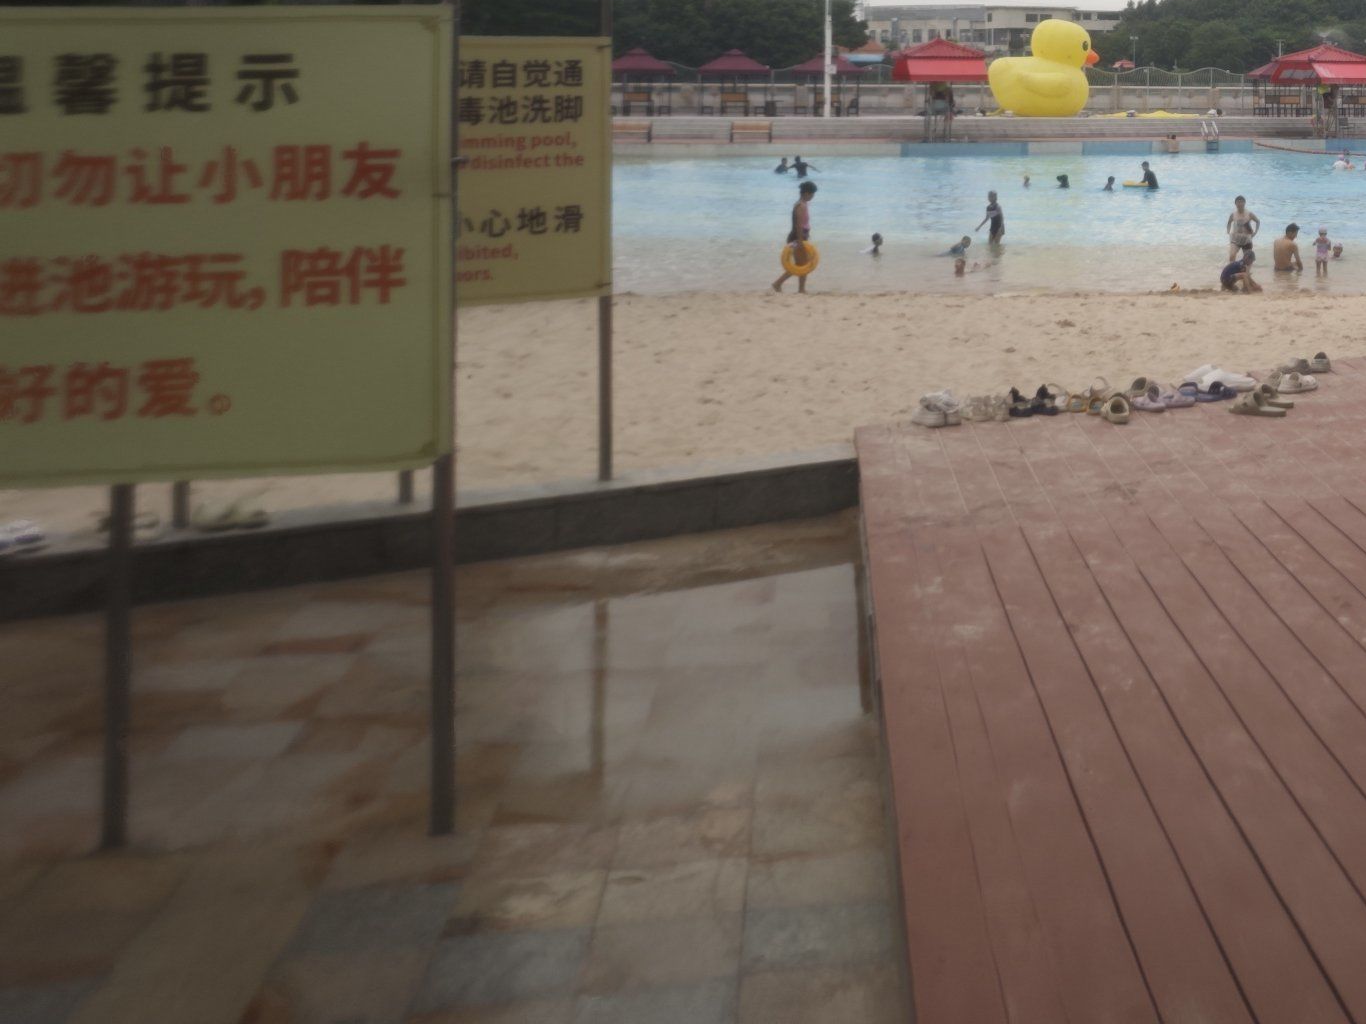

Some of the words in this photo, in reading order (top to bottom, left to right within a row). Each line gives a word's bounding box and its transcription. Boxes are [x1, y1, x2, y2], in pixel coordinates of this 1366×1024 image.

[459, 59, 584, 89] 请自觉通
[459, 95, 584, 126] 毒池洗脚
[531, 131, 577, 150] pool,
[471, 153, 550, 169] disinfect
[555, 152, 584, 168] the
